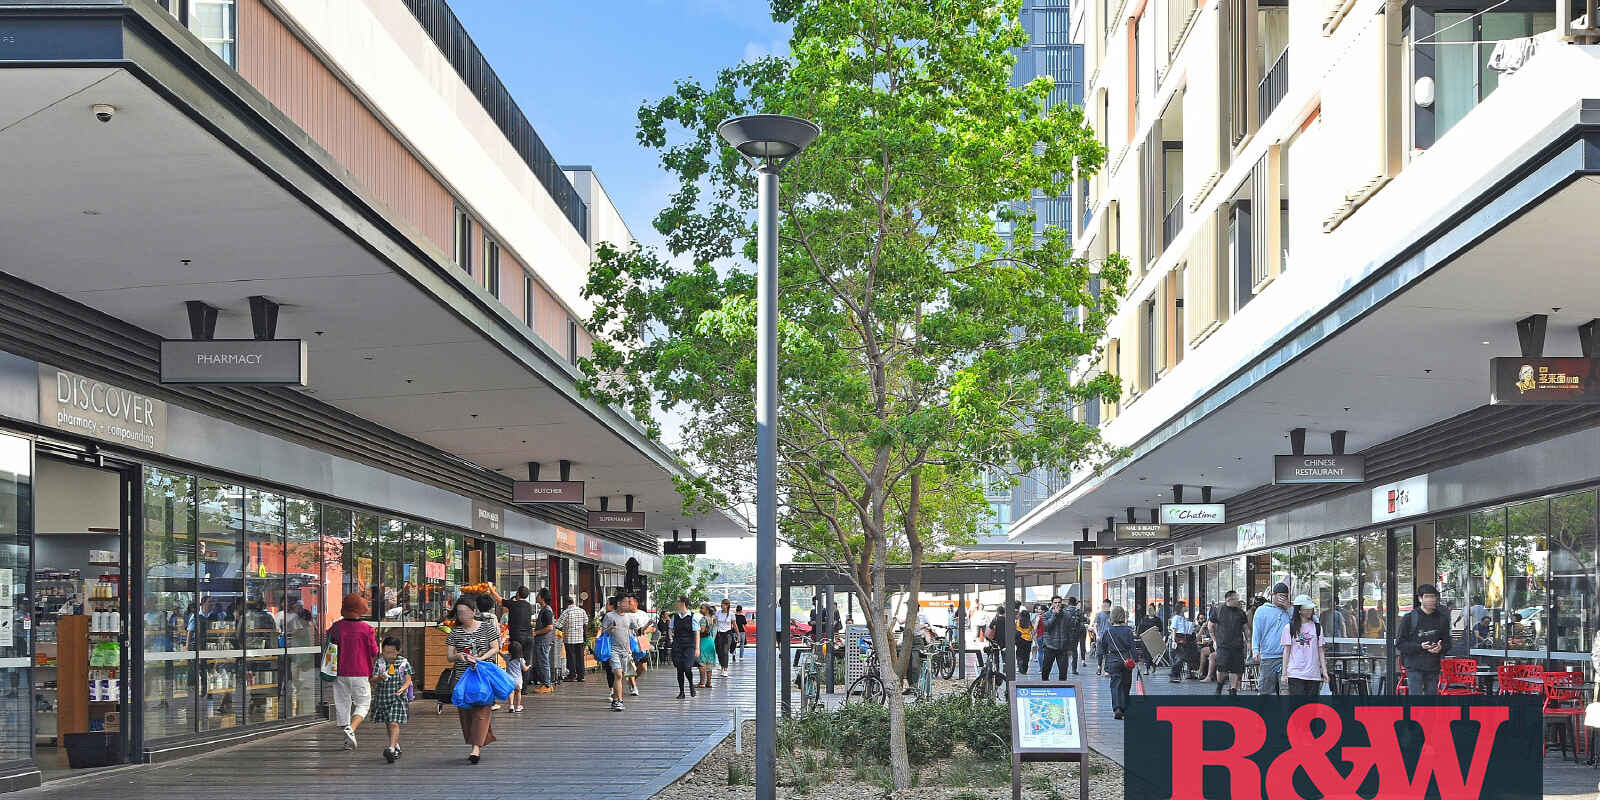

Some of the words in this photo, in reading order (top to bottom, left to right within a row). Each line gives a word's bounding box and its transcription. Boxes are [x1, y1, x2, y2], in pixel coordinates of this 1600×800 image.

[197, 354, 262, 364] PHARMACY
[56, 371, 154, 427] DISCOVER
[57, 407, 97, 432] pharmacy
[107, 424, 154, 448] compounding
[1295, 468, 1345, 476] RESTAURANT
[1179, 510, 1217, 519] Chatime
